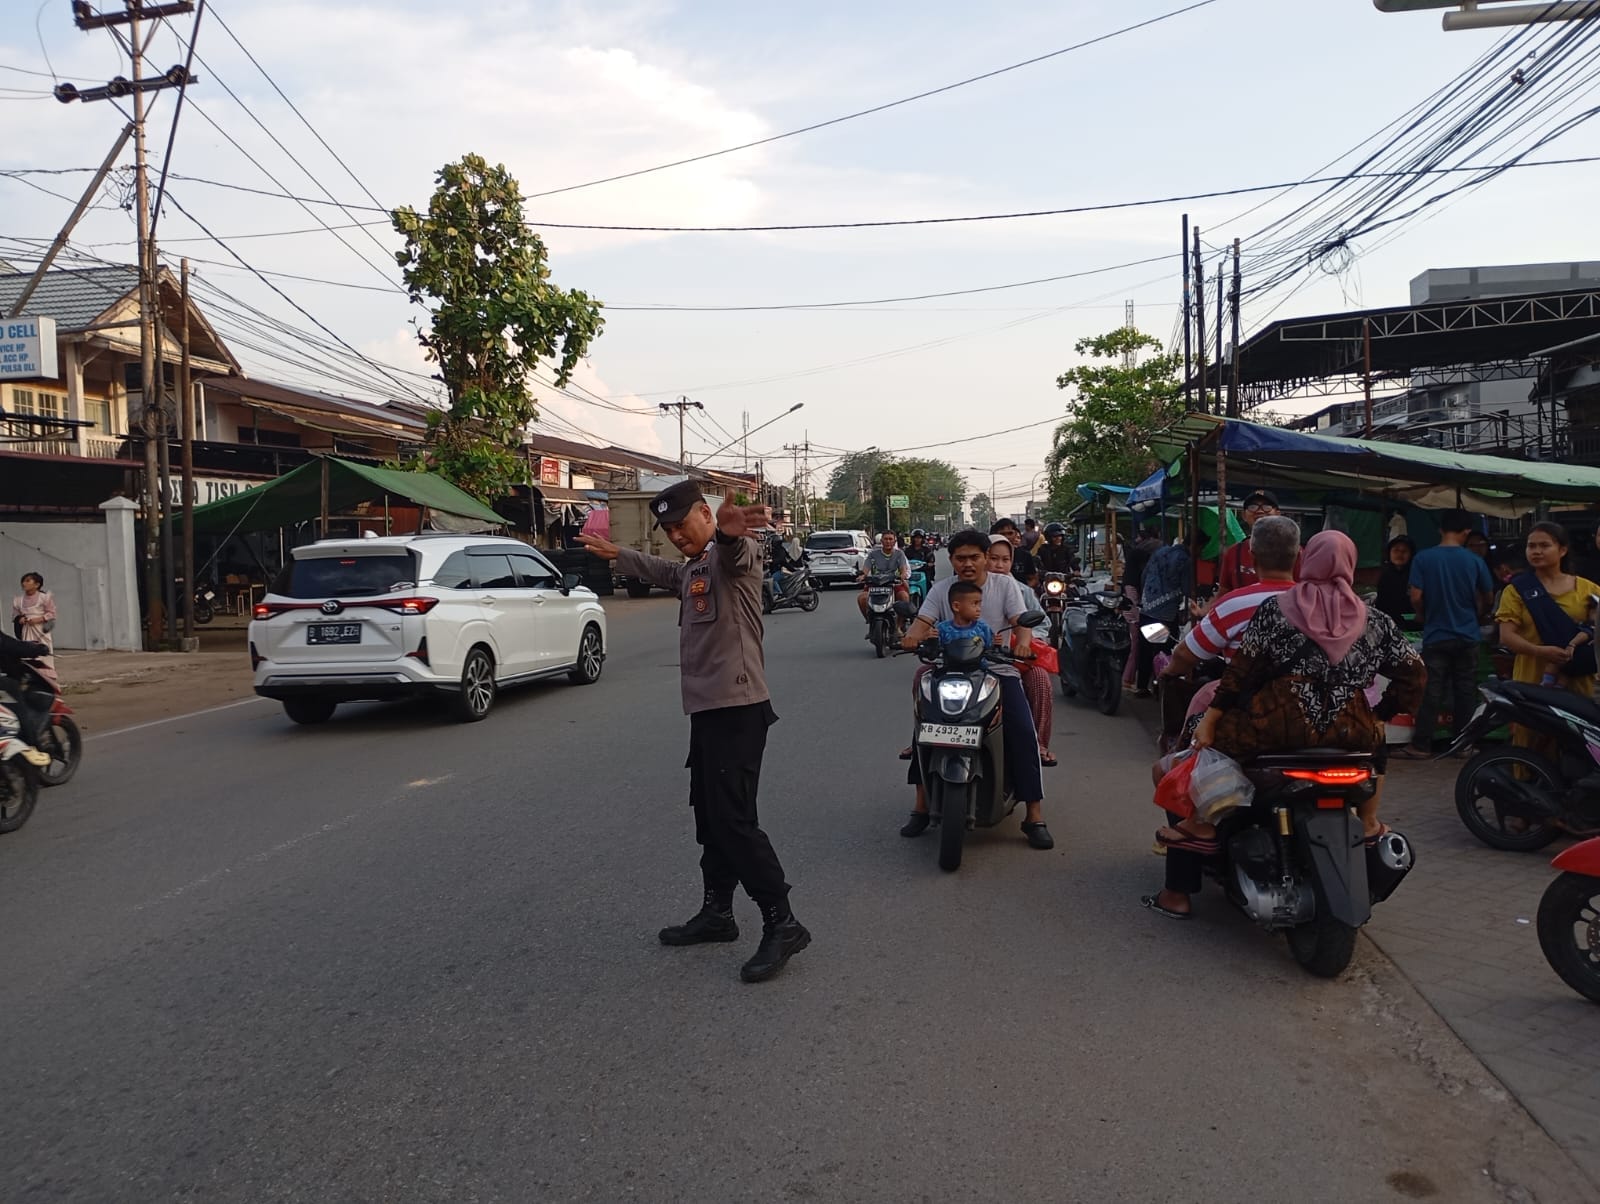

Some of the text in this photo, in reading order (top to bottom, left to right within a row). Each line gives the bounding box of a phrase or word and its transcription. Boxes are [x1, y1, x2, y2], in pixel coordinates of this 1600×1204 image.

[8, 324, 37, 339] CELL
[691, 565, 709, 577] POLRI
[920, 724, 979, 736] KB 4932 NM
